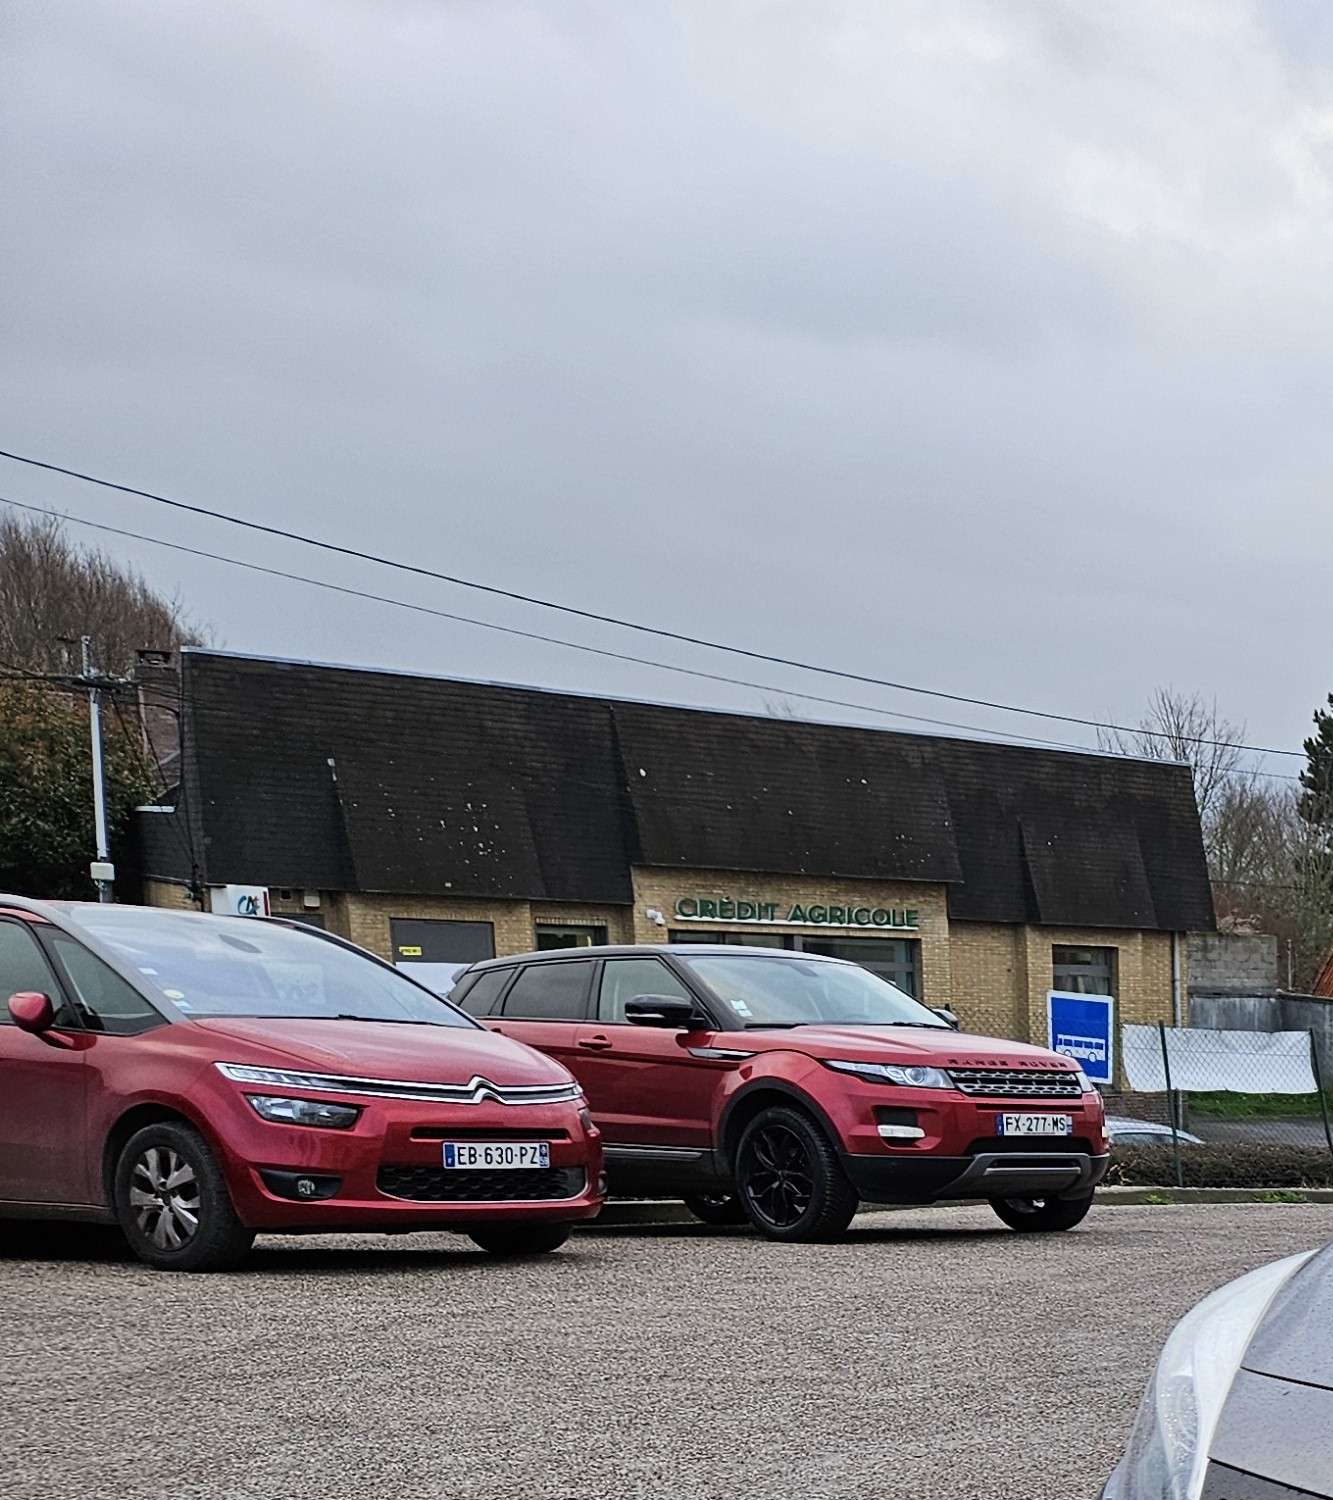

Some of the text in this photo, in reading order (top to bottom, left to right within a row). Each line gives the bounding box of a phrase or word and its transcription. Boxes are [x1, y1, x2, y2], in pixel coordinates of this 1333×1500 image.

[675, 895, 919, 927] CRÉDIT AGRICOLE
[947, 1059, 1009, 1067] RANGE
[1005, 1116, 1066, 1132] FX-277-MS
[457, 1146, 538, 1165] EB-630-PZ
